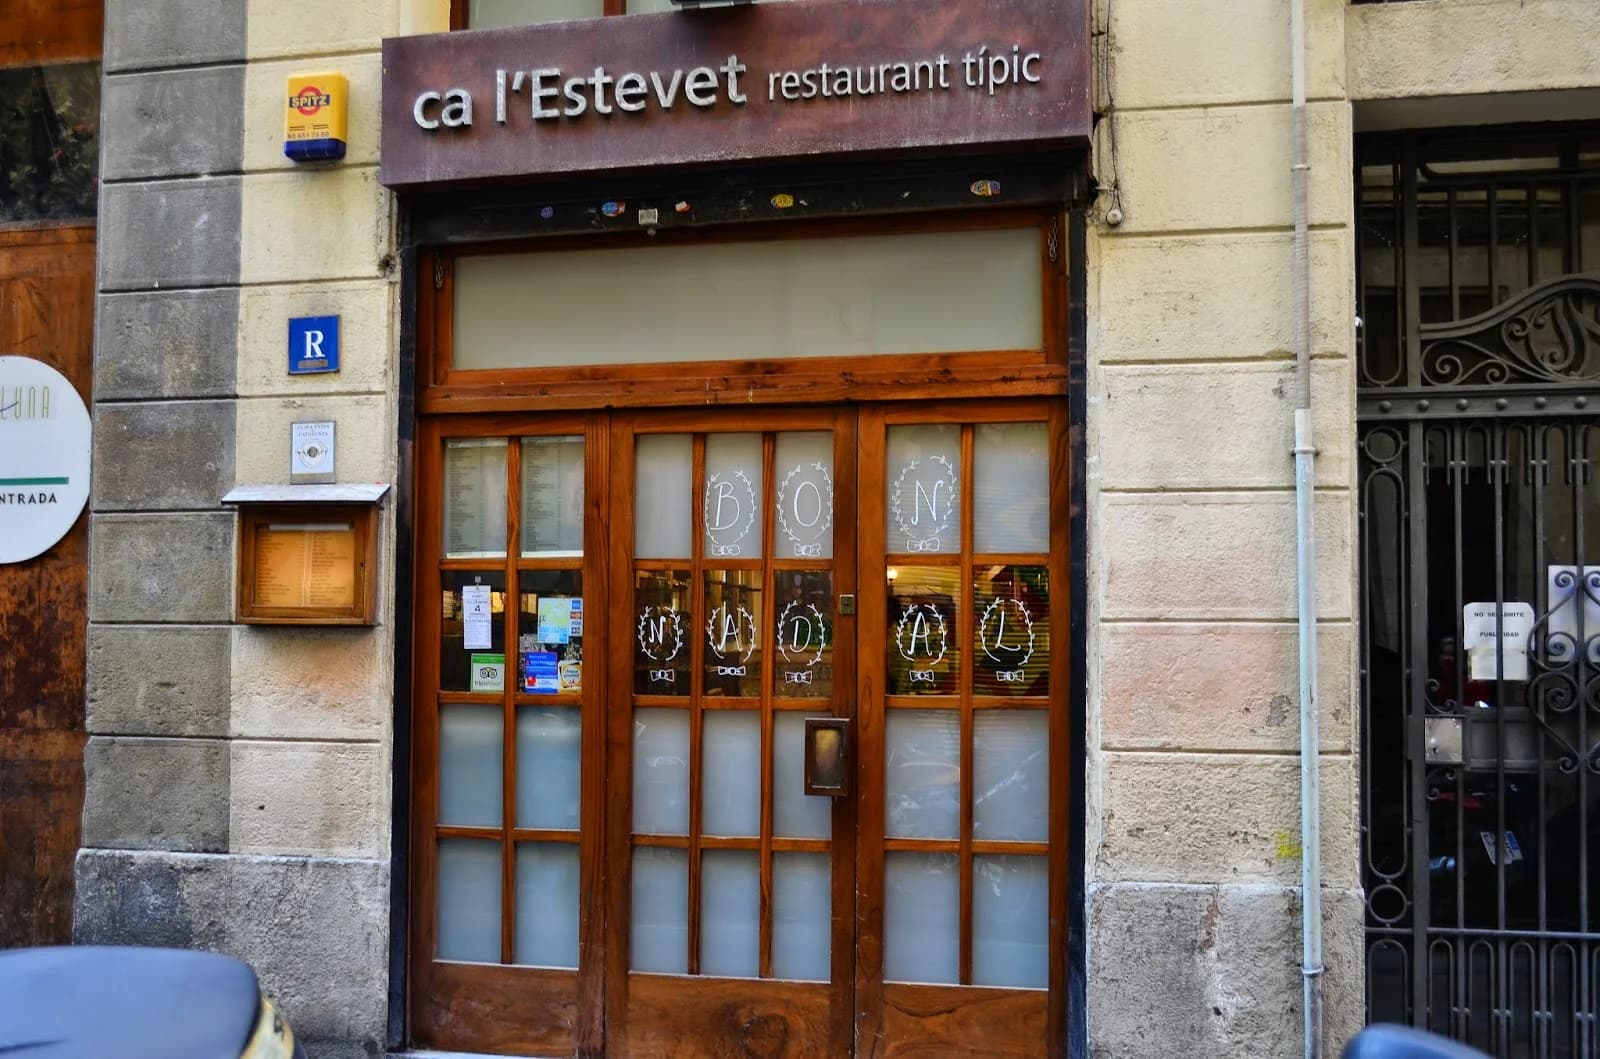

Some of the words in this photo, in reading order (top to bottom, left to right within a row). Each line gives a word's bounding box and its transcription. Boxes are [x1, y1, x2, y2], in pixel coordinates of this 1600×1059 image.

[413, 88, 473, 129] ca
[496, 54, 747, 123] l'Estevet
[768, 54, 950, 100] restaurant
[962, 44, 1041, 95] típic
[291, 95, 328, 107] SPITZ
[304, 330, 325, 358] R
